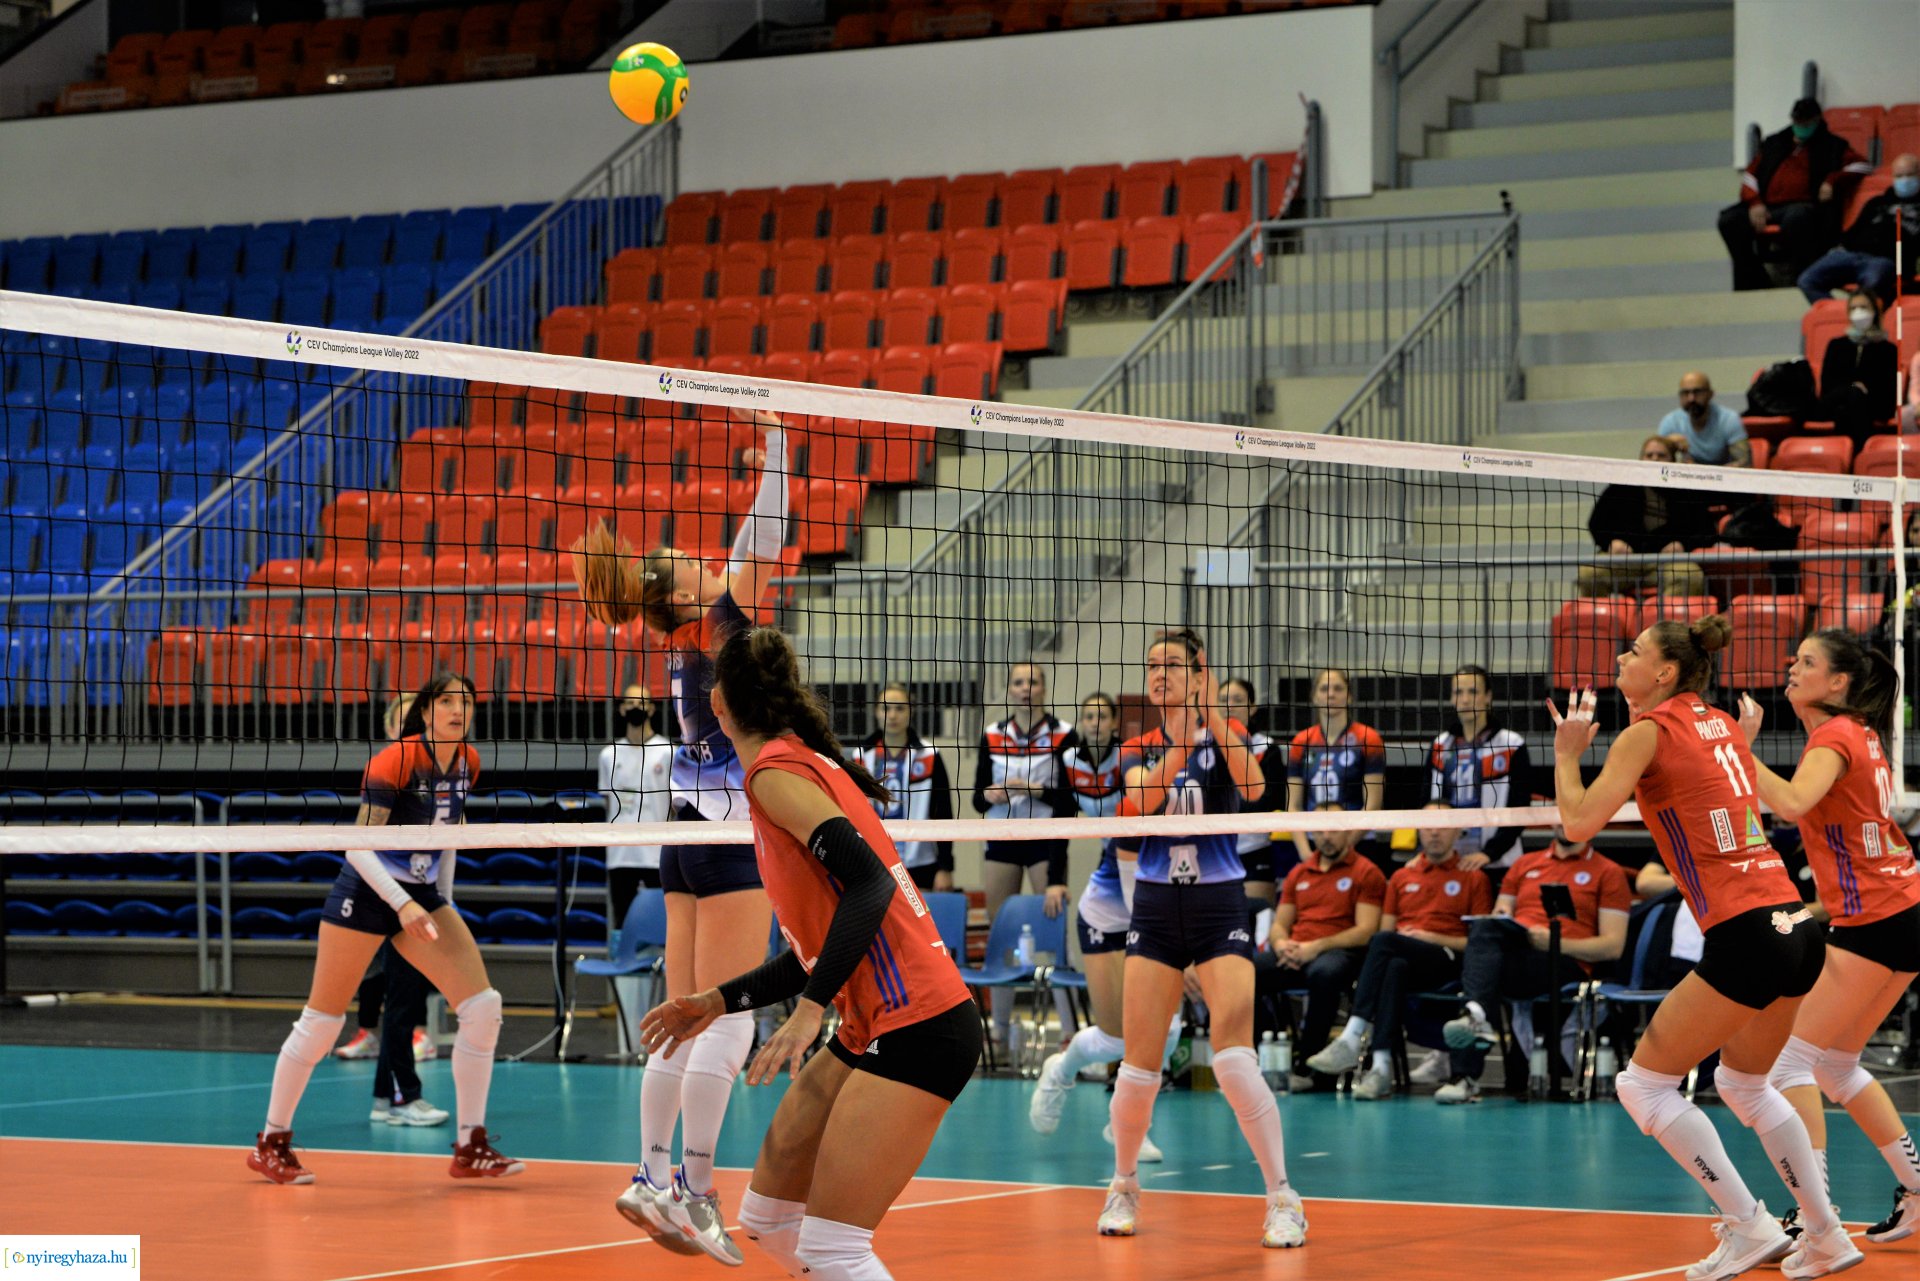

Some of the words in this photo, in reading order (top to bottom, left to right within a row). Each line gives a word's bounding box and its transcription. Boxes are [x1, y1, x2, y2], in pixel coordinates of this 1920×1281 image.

[307, 339, 321, 350] CEV
[322, 341, 358, 354] Champions
[360, 345, 382, 358] League
[384, 347, 403, 360] Volley
[404, 349, 419, 360] 2022
[676, 379, 688, 389] CEV
[689, 381, 719, 393] Champions
[720, 384, 740, 396] League
[740, 386, 757, 398] Volley
[757, 388, 770, 398] 2022
[985, 411, 995, 420] CEV
[995, 412, 1021, 423] Champions
[1022, 415, 1038, 425] League
[1039, 416, 1053, 427] Volley
[1053, 418, 1064, 427] 2022
[1247, 436, 1256, 445] CEV
[1256, 437, 1279, 447] Champions
[1279, 439, 1294, 449] League
[1694, 716, 1731, 740] PINTÉR
[1713, 742, 1753, 797] 11
[1874, 766, 1890, 819] 10
[1714, 810, 1733, 850] STRABAG
[341, 898, 354, 918] 5
[1087, 928, 1104, 945] 14
[1694, 1154, 1719, 1183] MIKASA
[1780, 1157, 1800, 1188] MIKASA
